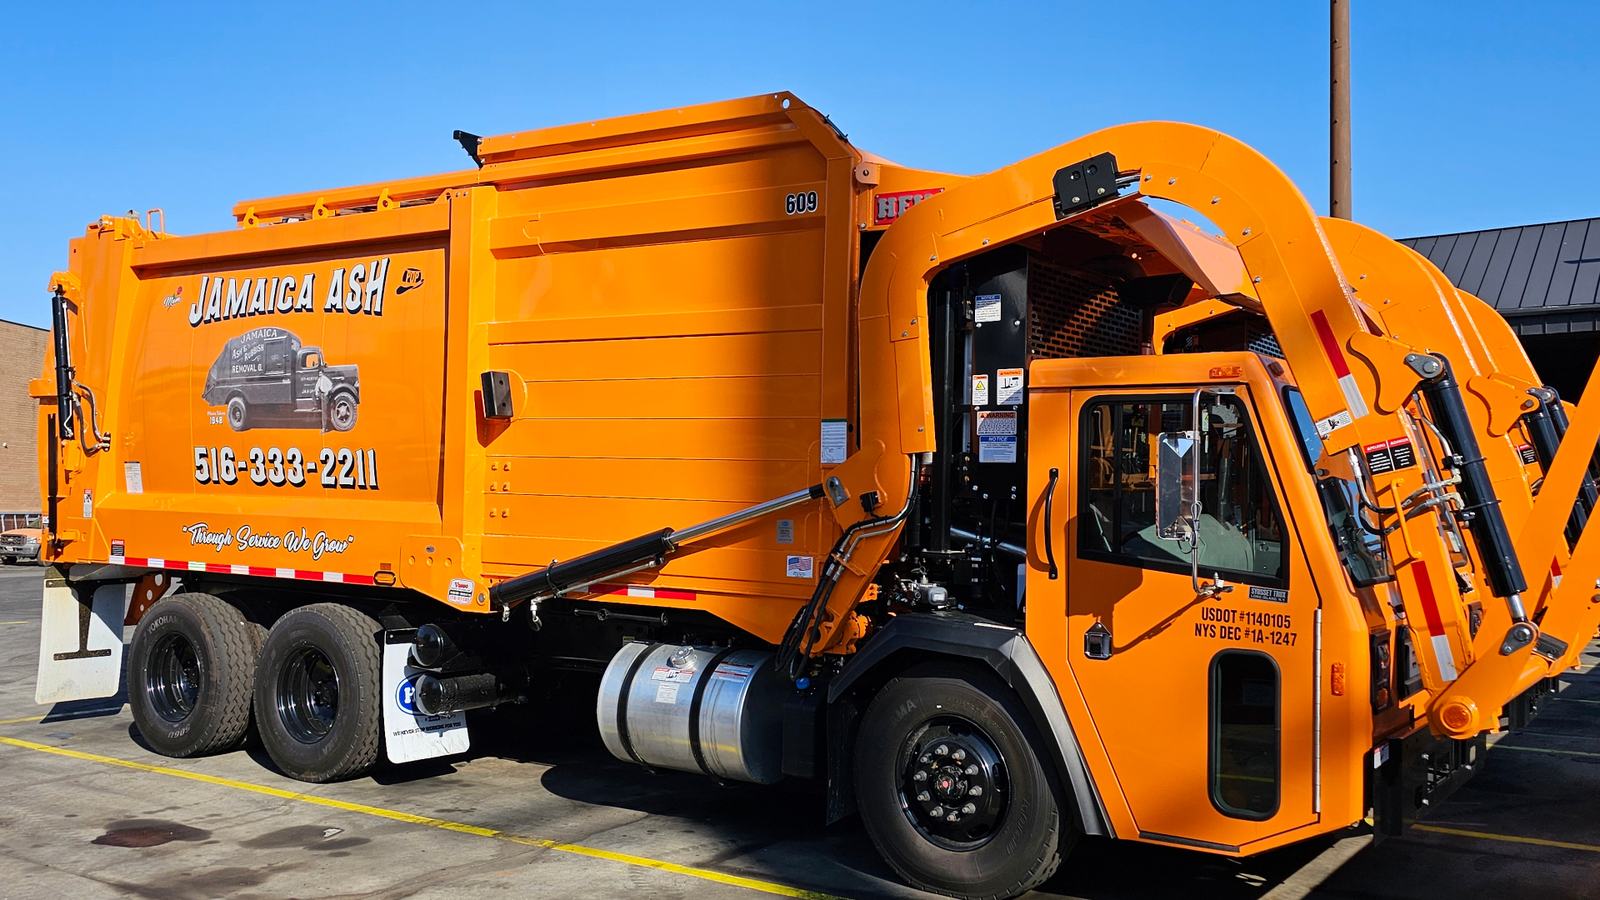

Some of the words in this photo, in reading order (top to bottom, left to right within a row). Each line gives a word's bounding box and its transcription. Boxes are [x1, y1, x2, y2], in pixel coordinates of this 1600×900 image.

[785, 191, 817, 215] 609
[876, 193, 934, 219] HE
[188, 273, 315, 328] JAMAICA
[324, 257, 390, 317] ASH
[240, 328, 278, 344] JAMAICA
[231, 365, 256, 374] REMOVAL
[193, 446, 380, 491] 516-333-2211
[235, 525, 281, 551] Service
[283, 528, 312, 552] We
[1201, 607, 1238, 624] USDOT
[1239, 611, 1291, 629] #1140105
[1194, 623, 1217, 639] NYS
[1219, 625, 1242, 641] DEC
[1244, 627, 1298, 647] #1A-1247
